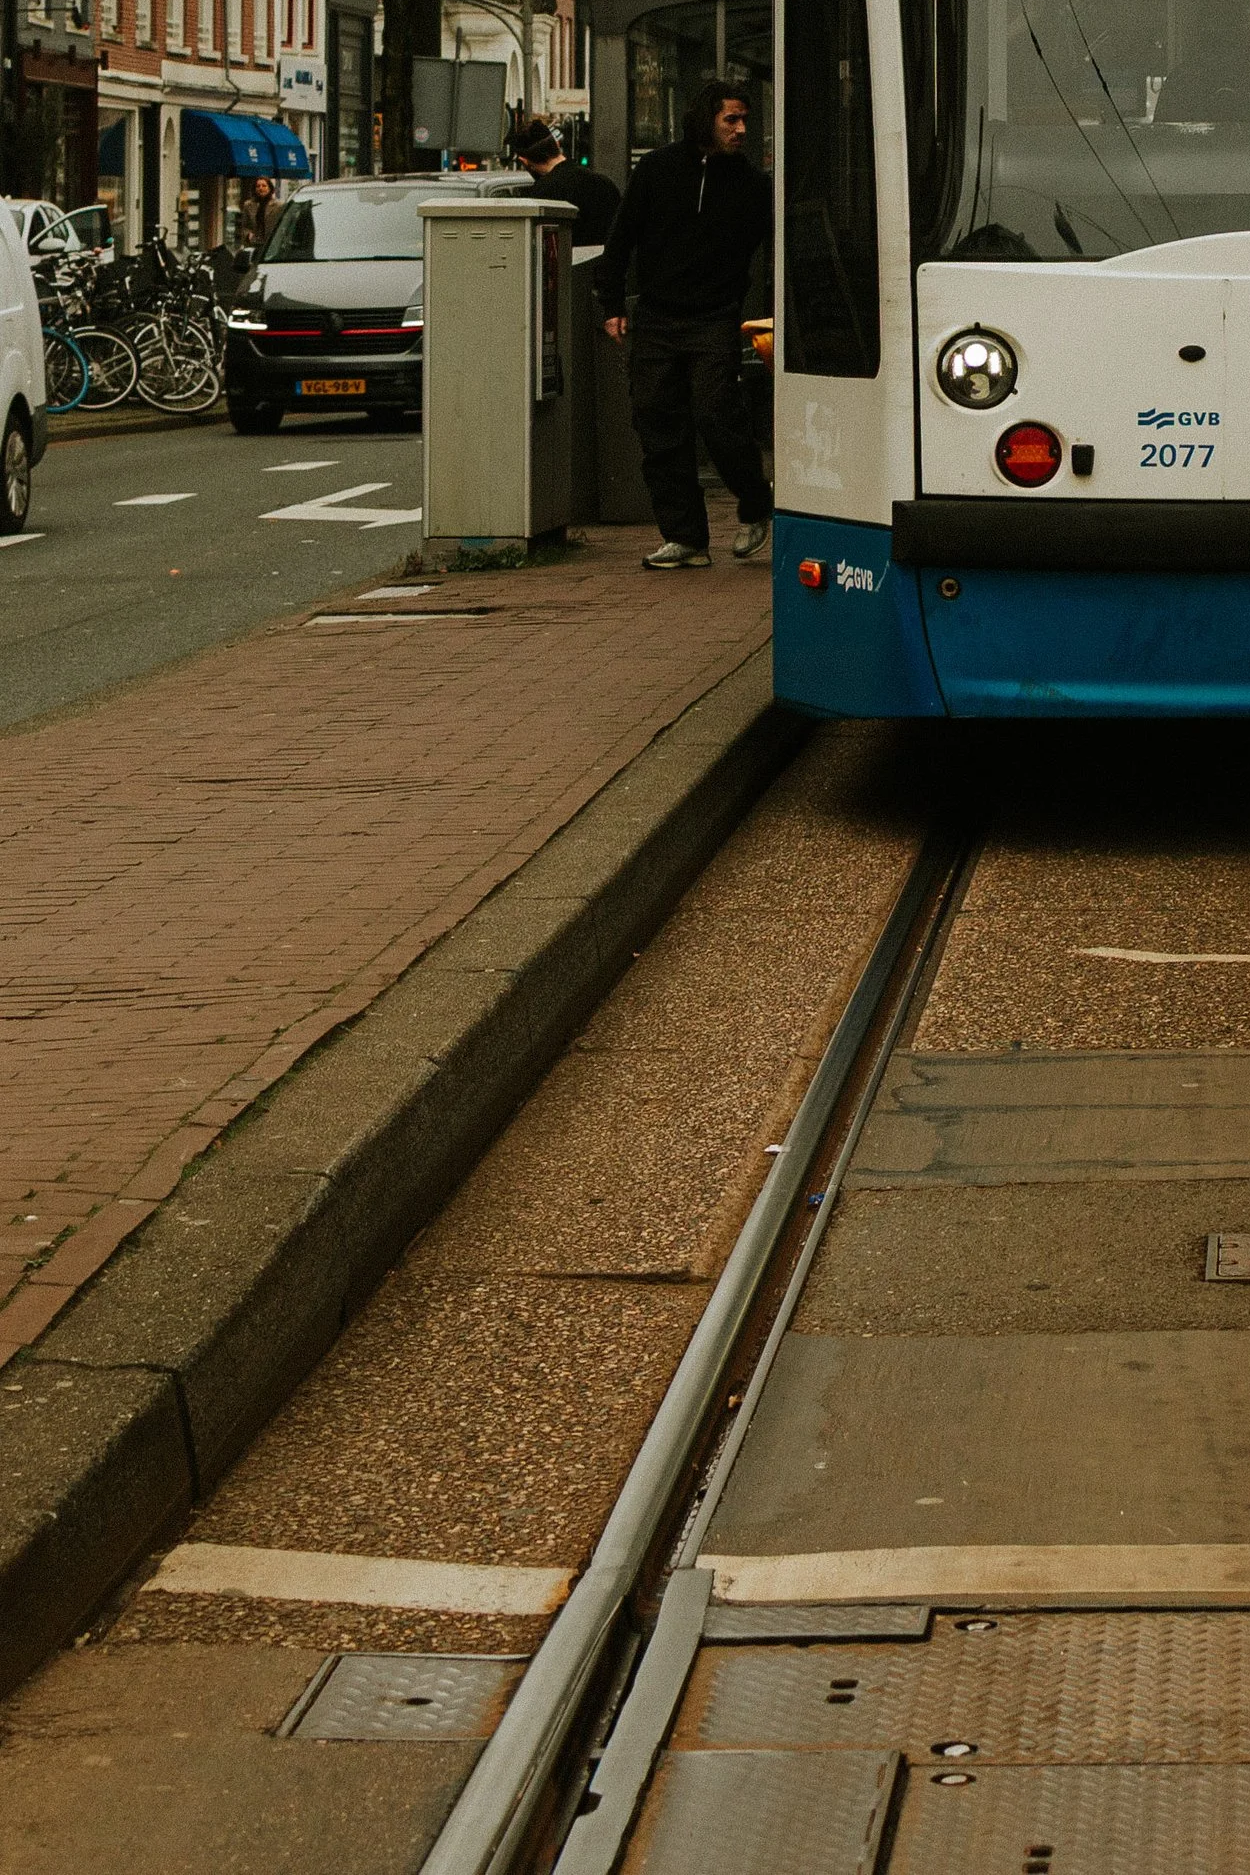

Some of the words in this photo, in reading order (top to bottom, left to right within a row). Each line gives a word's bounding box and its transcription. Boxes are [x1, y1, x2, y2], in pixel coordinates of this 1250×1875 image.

[1178, 412, 1220, 426] GVB
[1140, 443, 1215, 468] 2077
[854, 567, 873, 592] GVB
